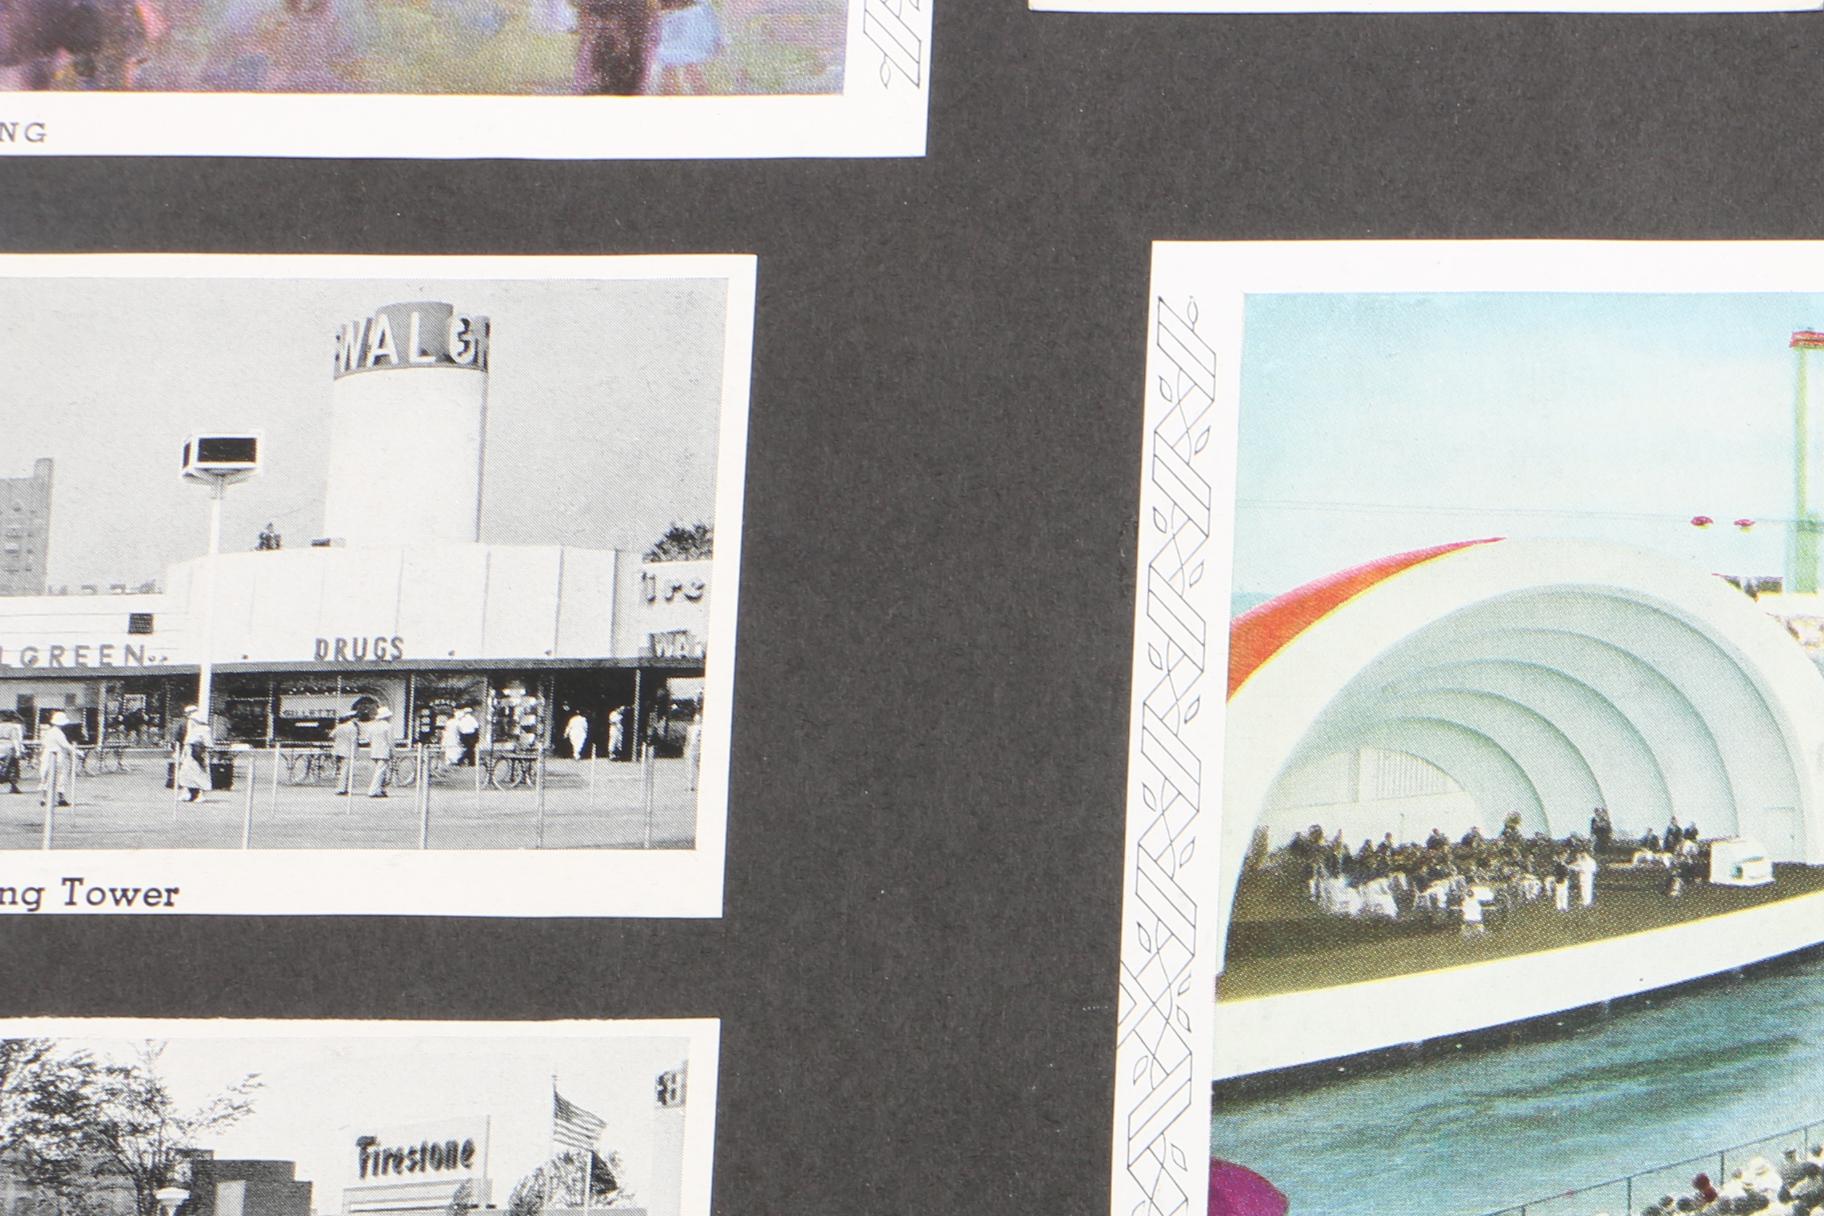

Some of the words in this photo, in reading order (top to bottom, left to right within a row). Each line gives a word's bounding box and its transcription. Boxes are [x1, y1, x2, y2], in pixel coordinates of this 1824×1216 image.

[0, 121, 47, 143] NG
[314, 636, 404, 662] DRUGS
[0, 886, 46, 912] ng
[61, 877, 180, 907] Tower
[355, 1135, 476, 1179] Firestone
